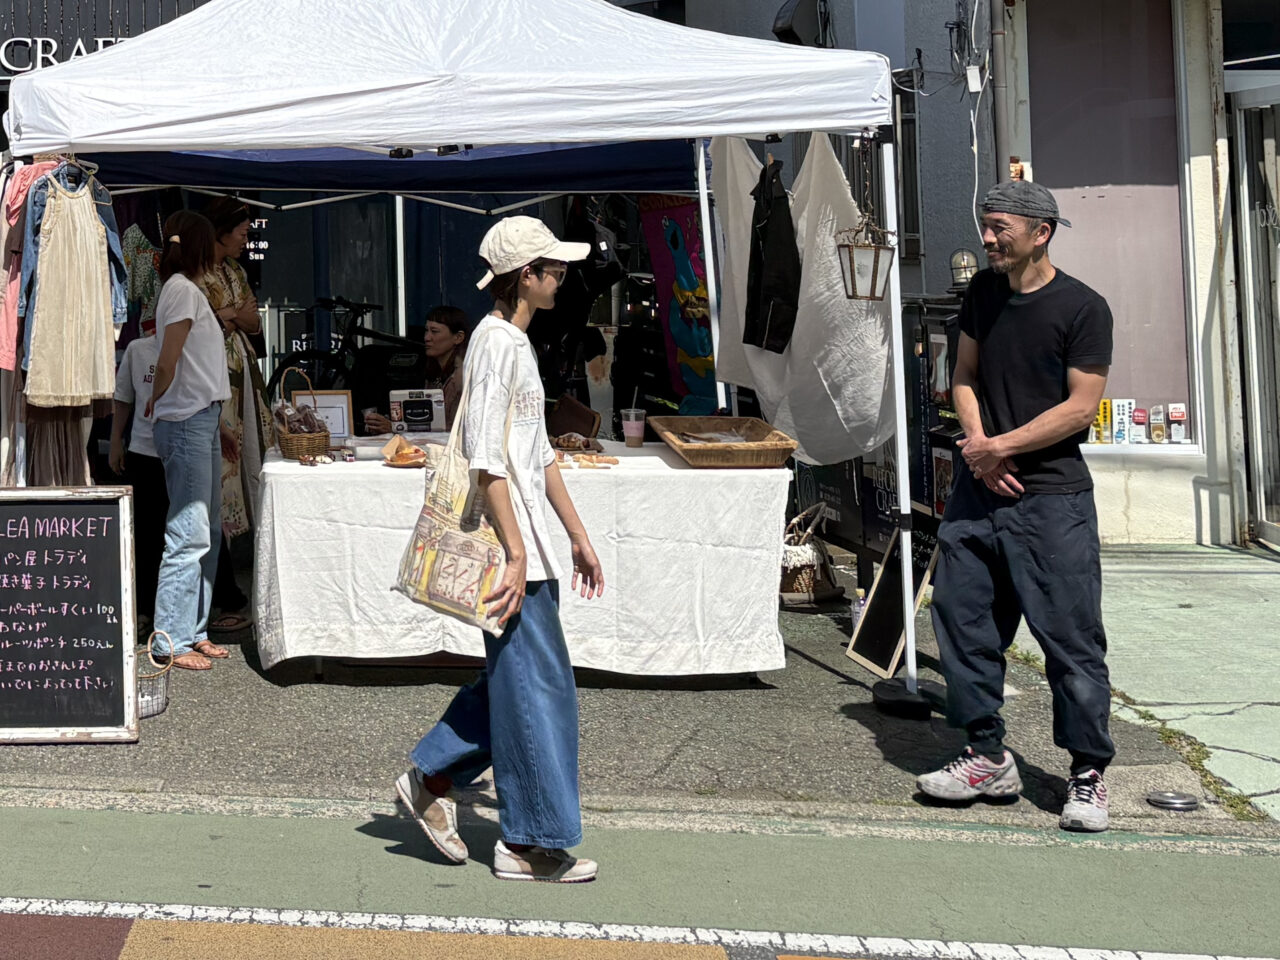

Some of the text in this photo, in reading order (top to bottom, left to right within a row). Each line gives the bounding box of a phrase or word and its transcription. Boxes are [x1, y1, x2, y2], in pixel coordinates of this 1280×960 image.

[0, 37, 134, 72] CRA
[248, 251, 265, 260] Sun
[34, 516, 113, 539] MARKET
[44, 549, 87, 565] トラディ
[53, 575, 91, 590] トラディ
[73, 638, 114, 649] 250えん
